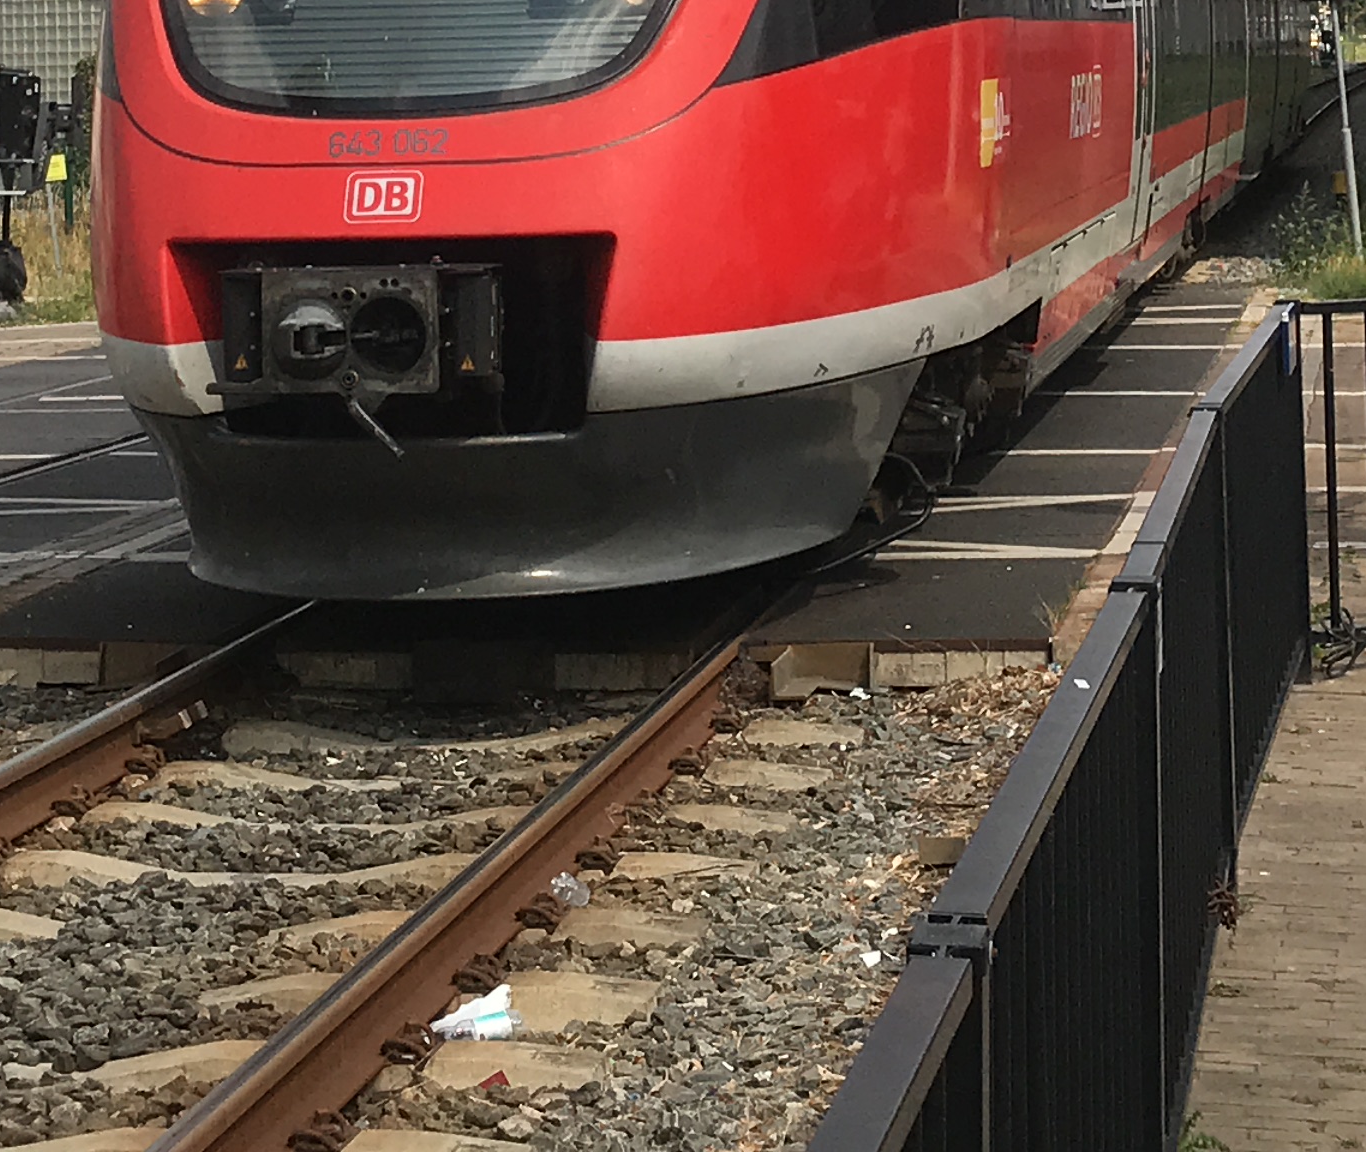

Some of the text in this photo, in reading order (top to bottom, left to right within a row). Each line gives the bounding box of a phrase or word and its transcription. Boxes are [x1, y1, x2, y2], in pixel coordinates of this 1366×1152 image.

[328, 128, 449, 159] 643 062
[356, 181, 409, 213] DB
